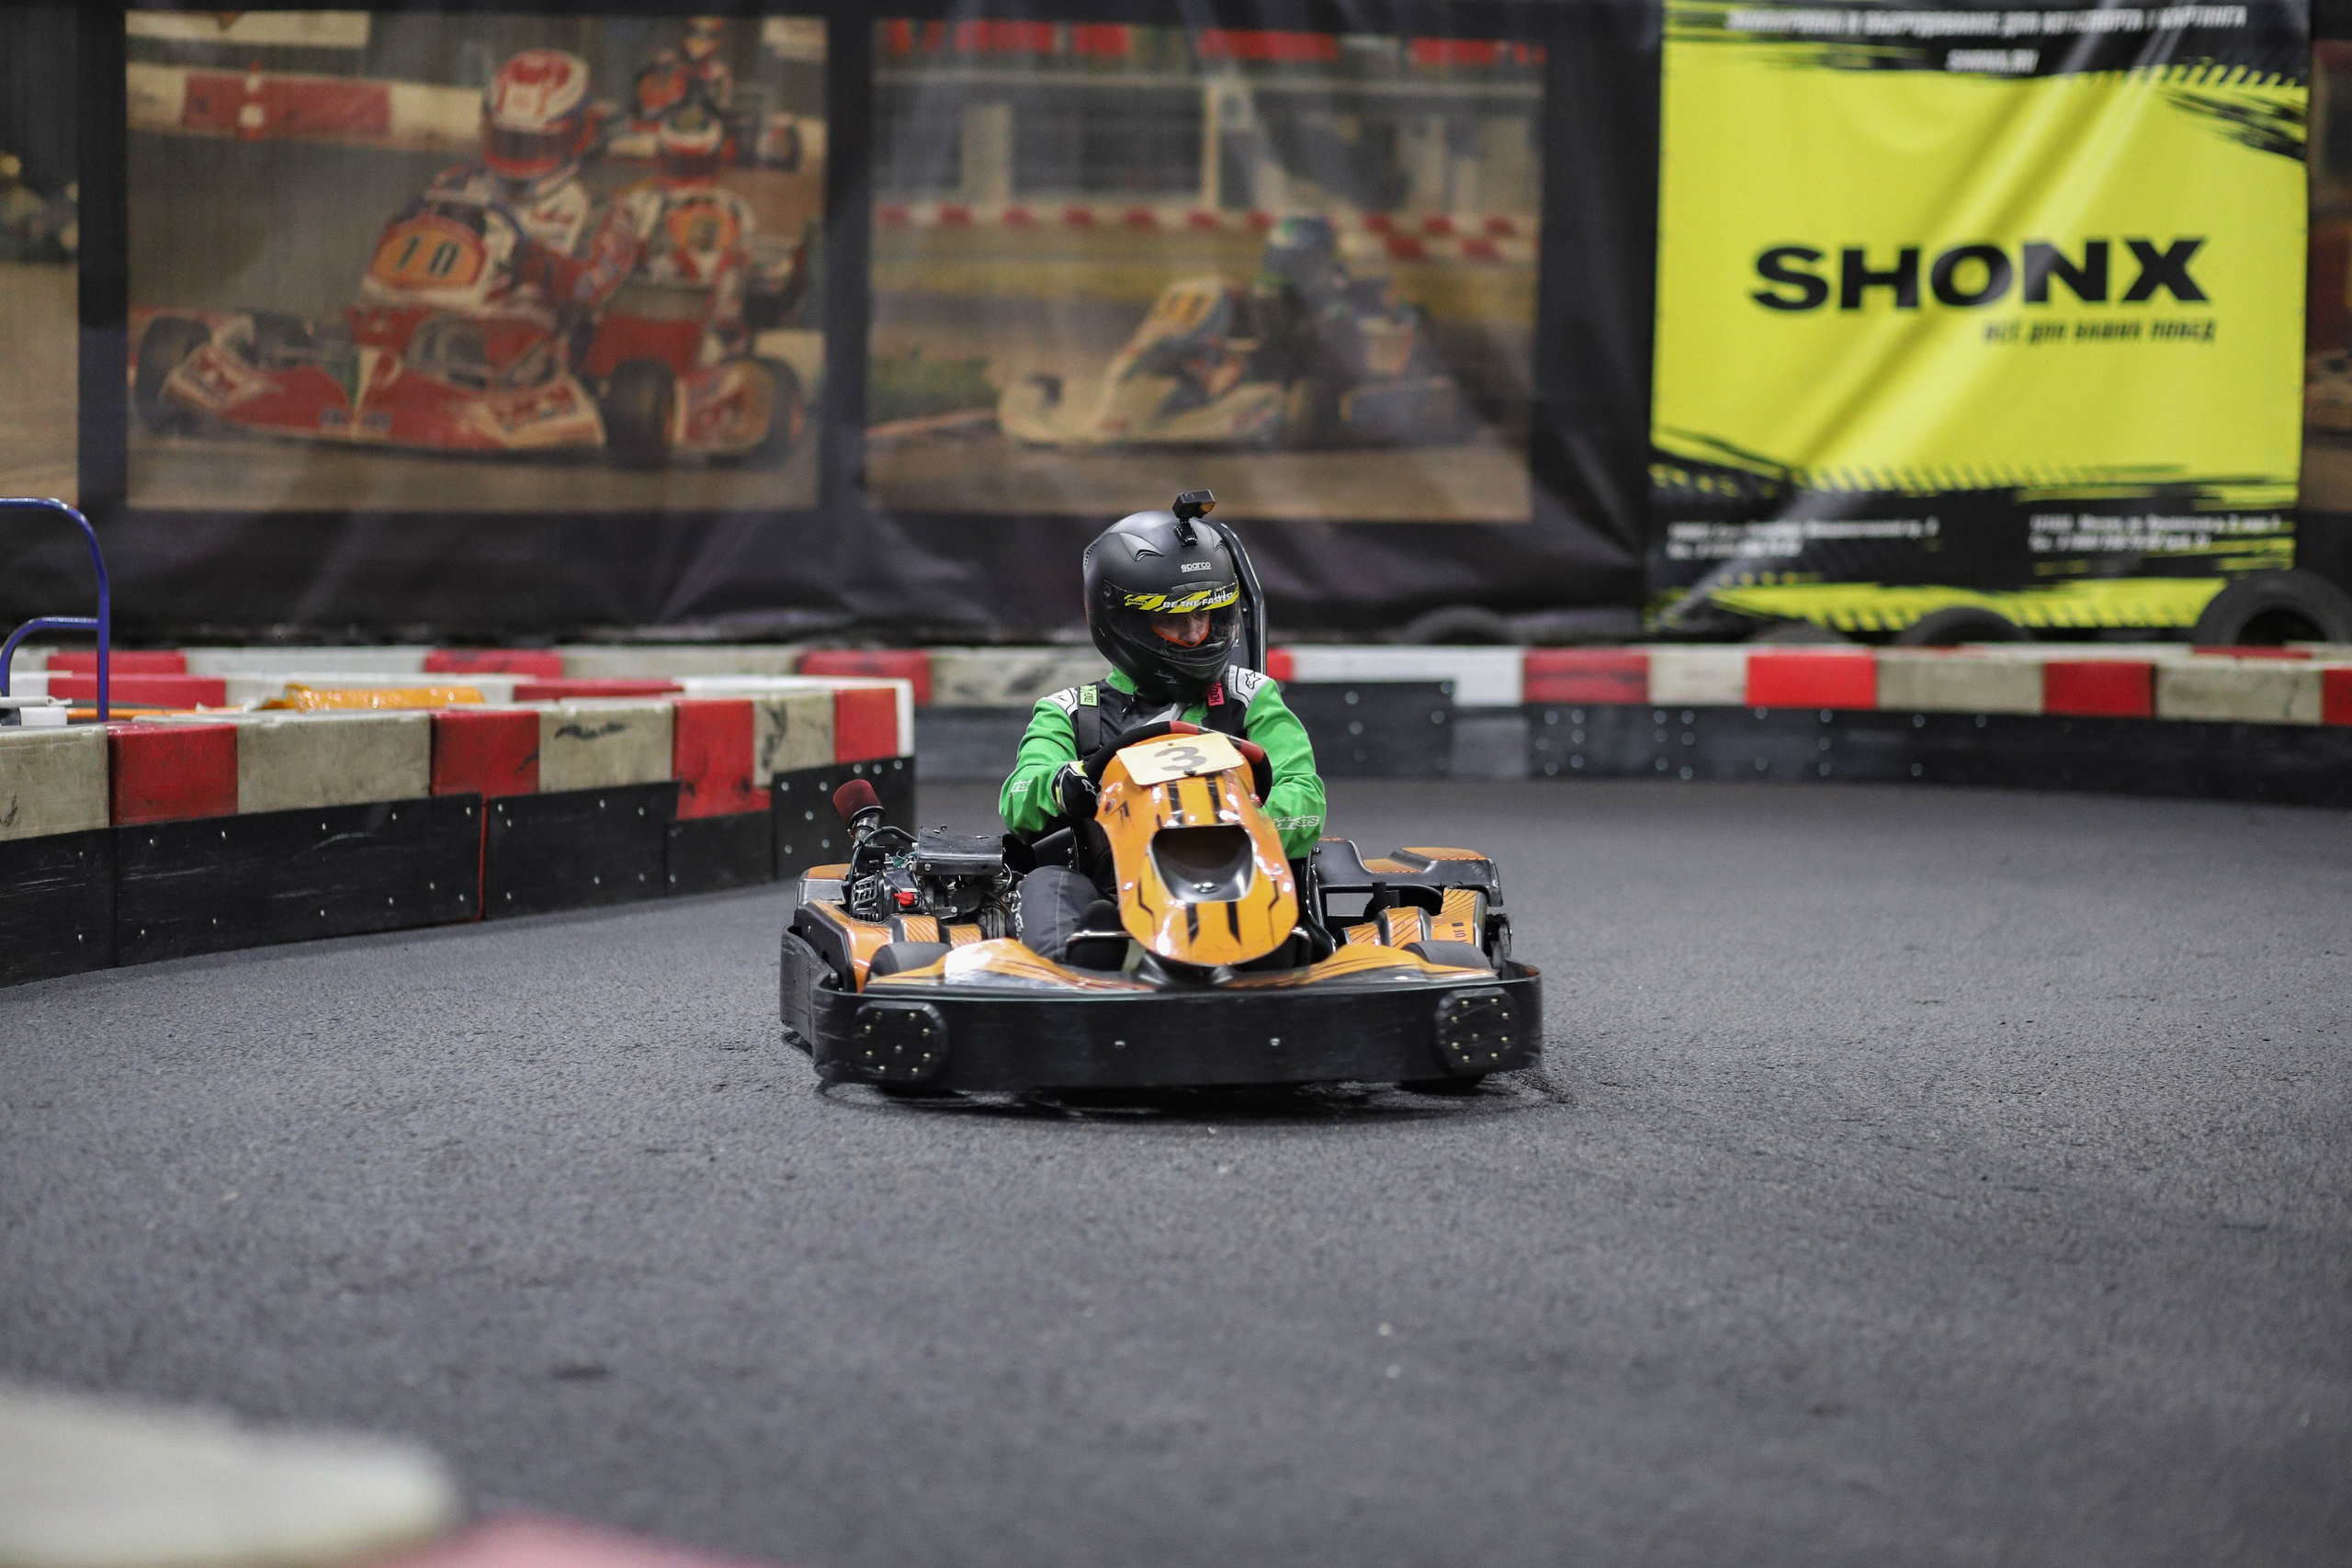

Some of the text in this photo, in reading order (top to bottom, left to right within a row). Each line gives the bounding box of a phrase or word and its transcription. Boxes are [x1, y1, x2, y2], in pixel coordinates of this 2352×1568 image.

[1749, 238, 2210, 310] SHONX
[1181, 561, 1212, 573] sparco
[1162, 601, 1178, 609] BE
[1181, 599, 1201, 608] THE
[1154, 746, 1207, 772] 3
